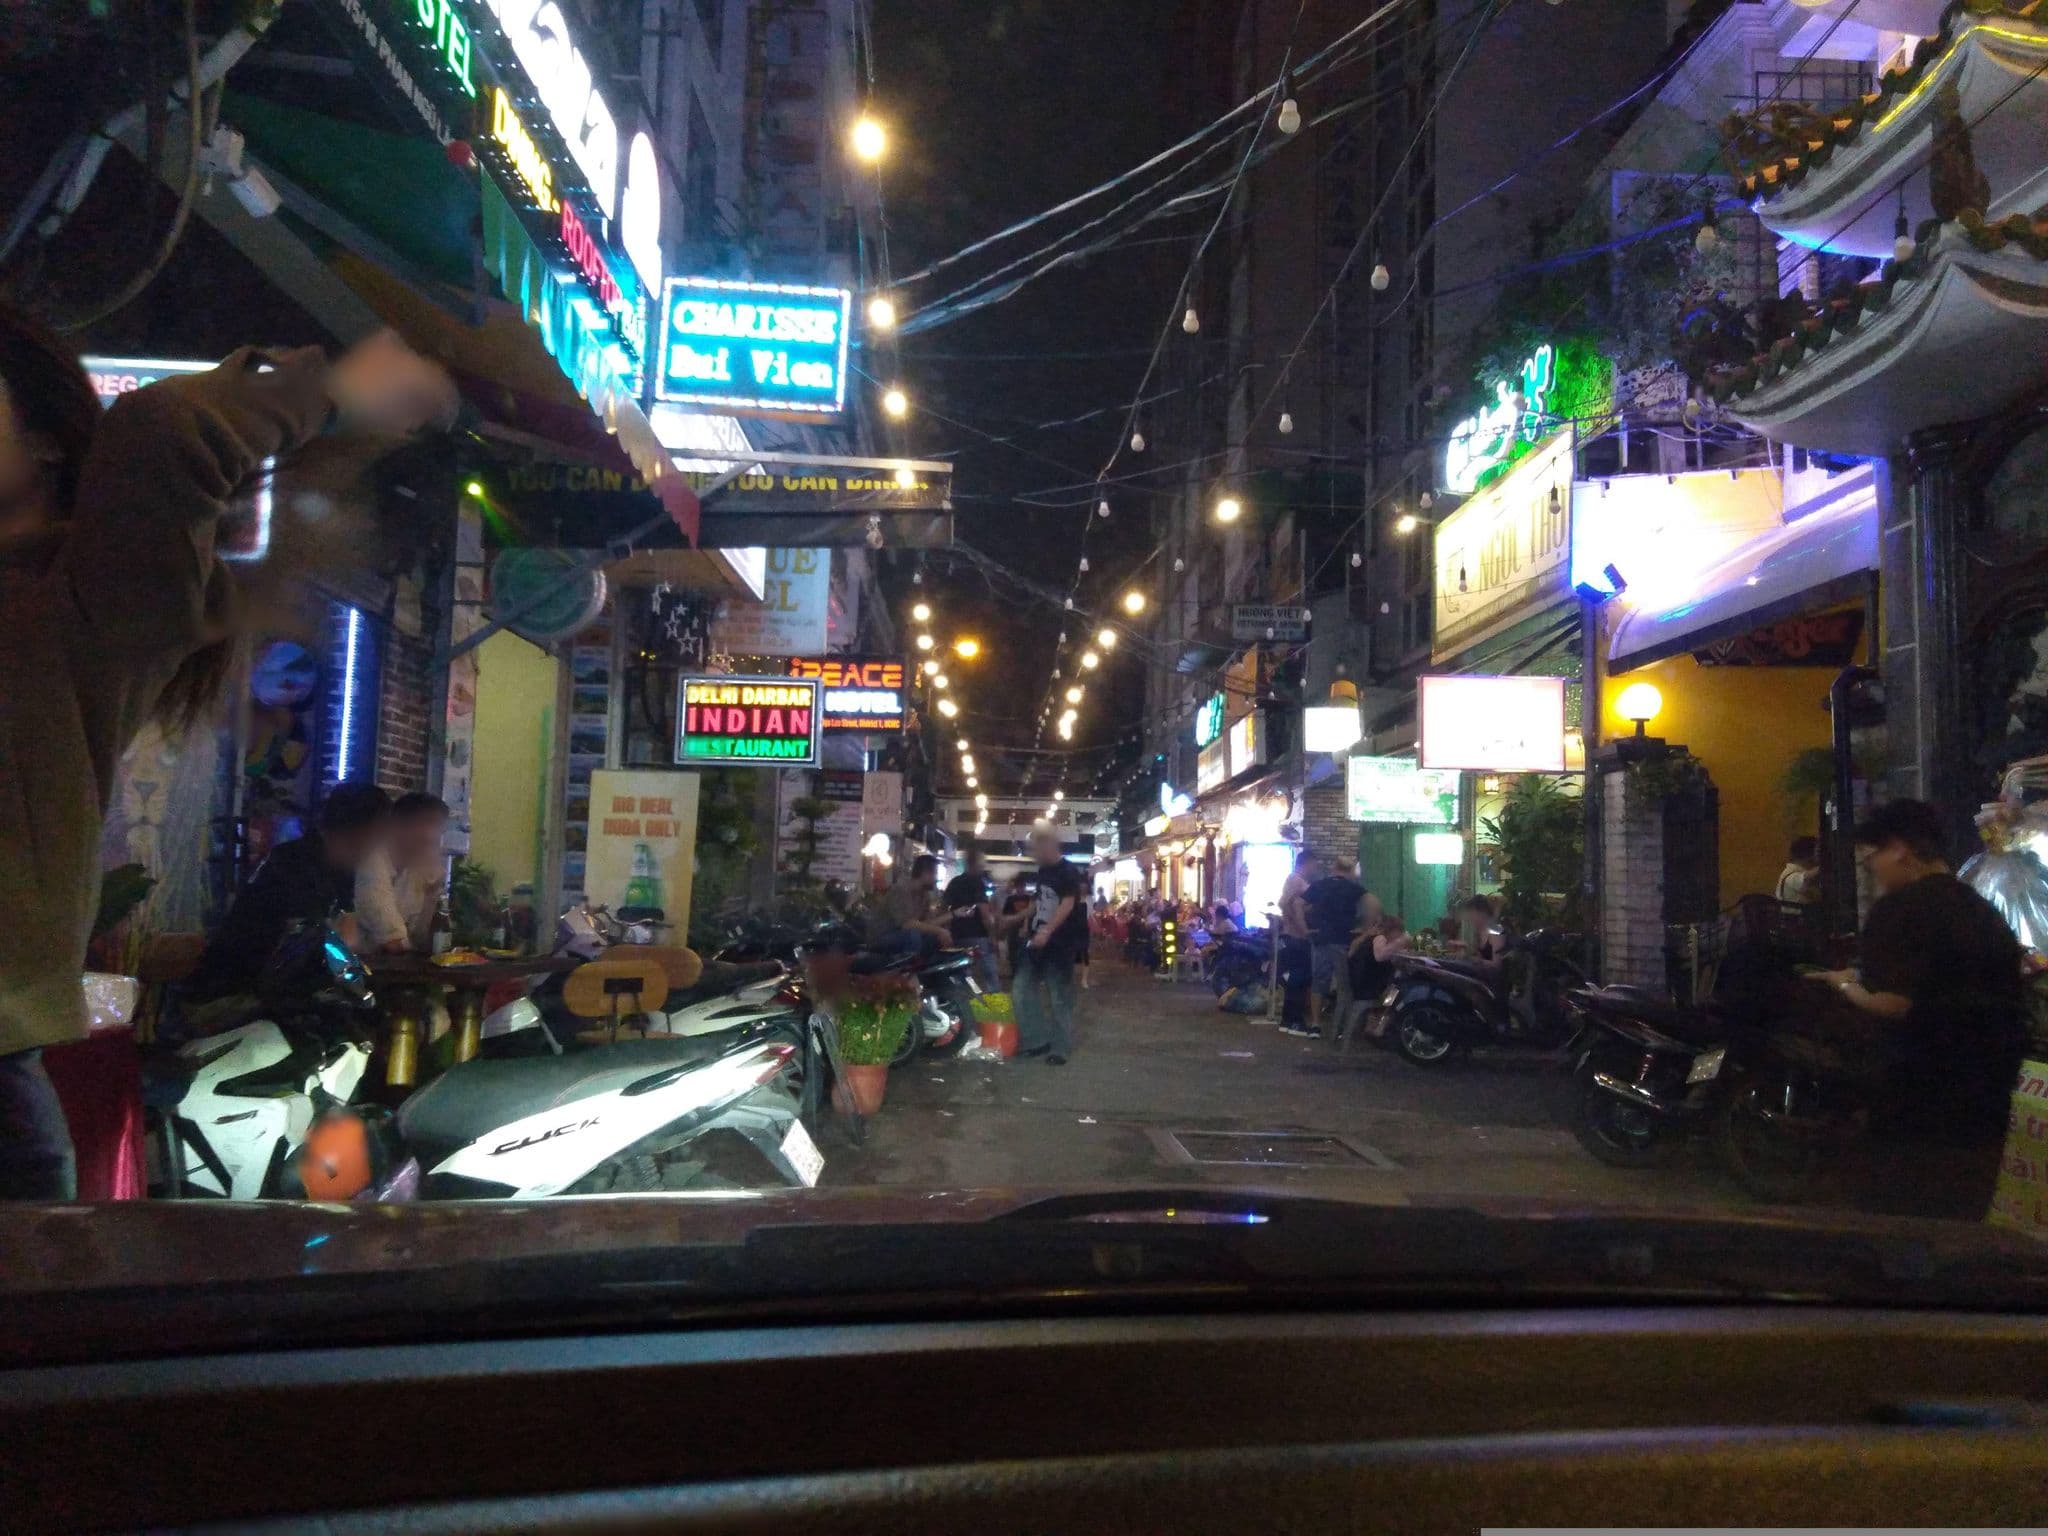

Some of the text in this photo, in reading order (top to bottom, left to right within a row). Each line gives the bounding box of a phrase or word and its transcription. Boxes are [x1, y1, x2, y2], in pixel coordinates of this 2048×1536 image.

[672, 301, 837, 344] CHARISSE
[567, 468, 622, 491] CAN
[742, 687, 812, 706] DARBAR
[687, 707, 809, 734] INDIAN
[645, 820, 681, 837] ONLY
